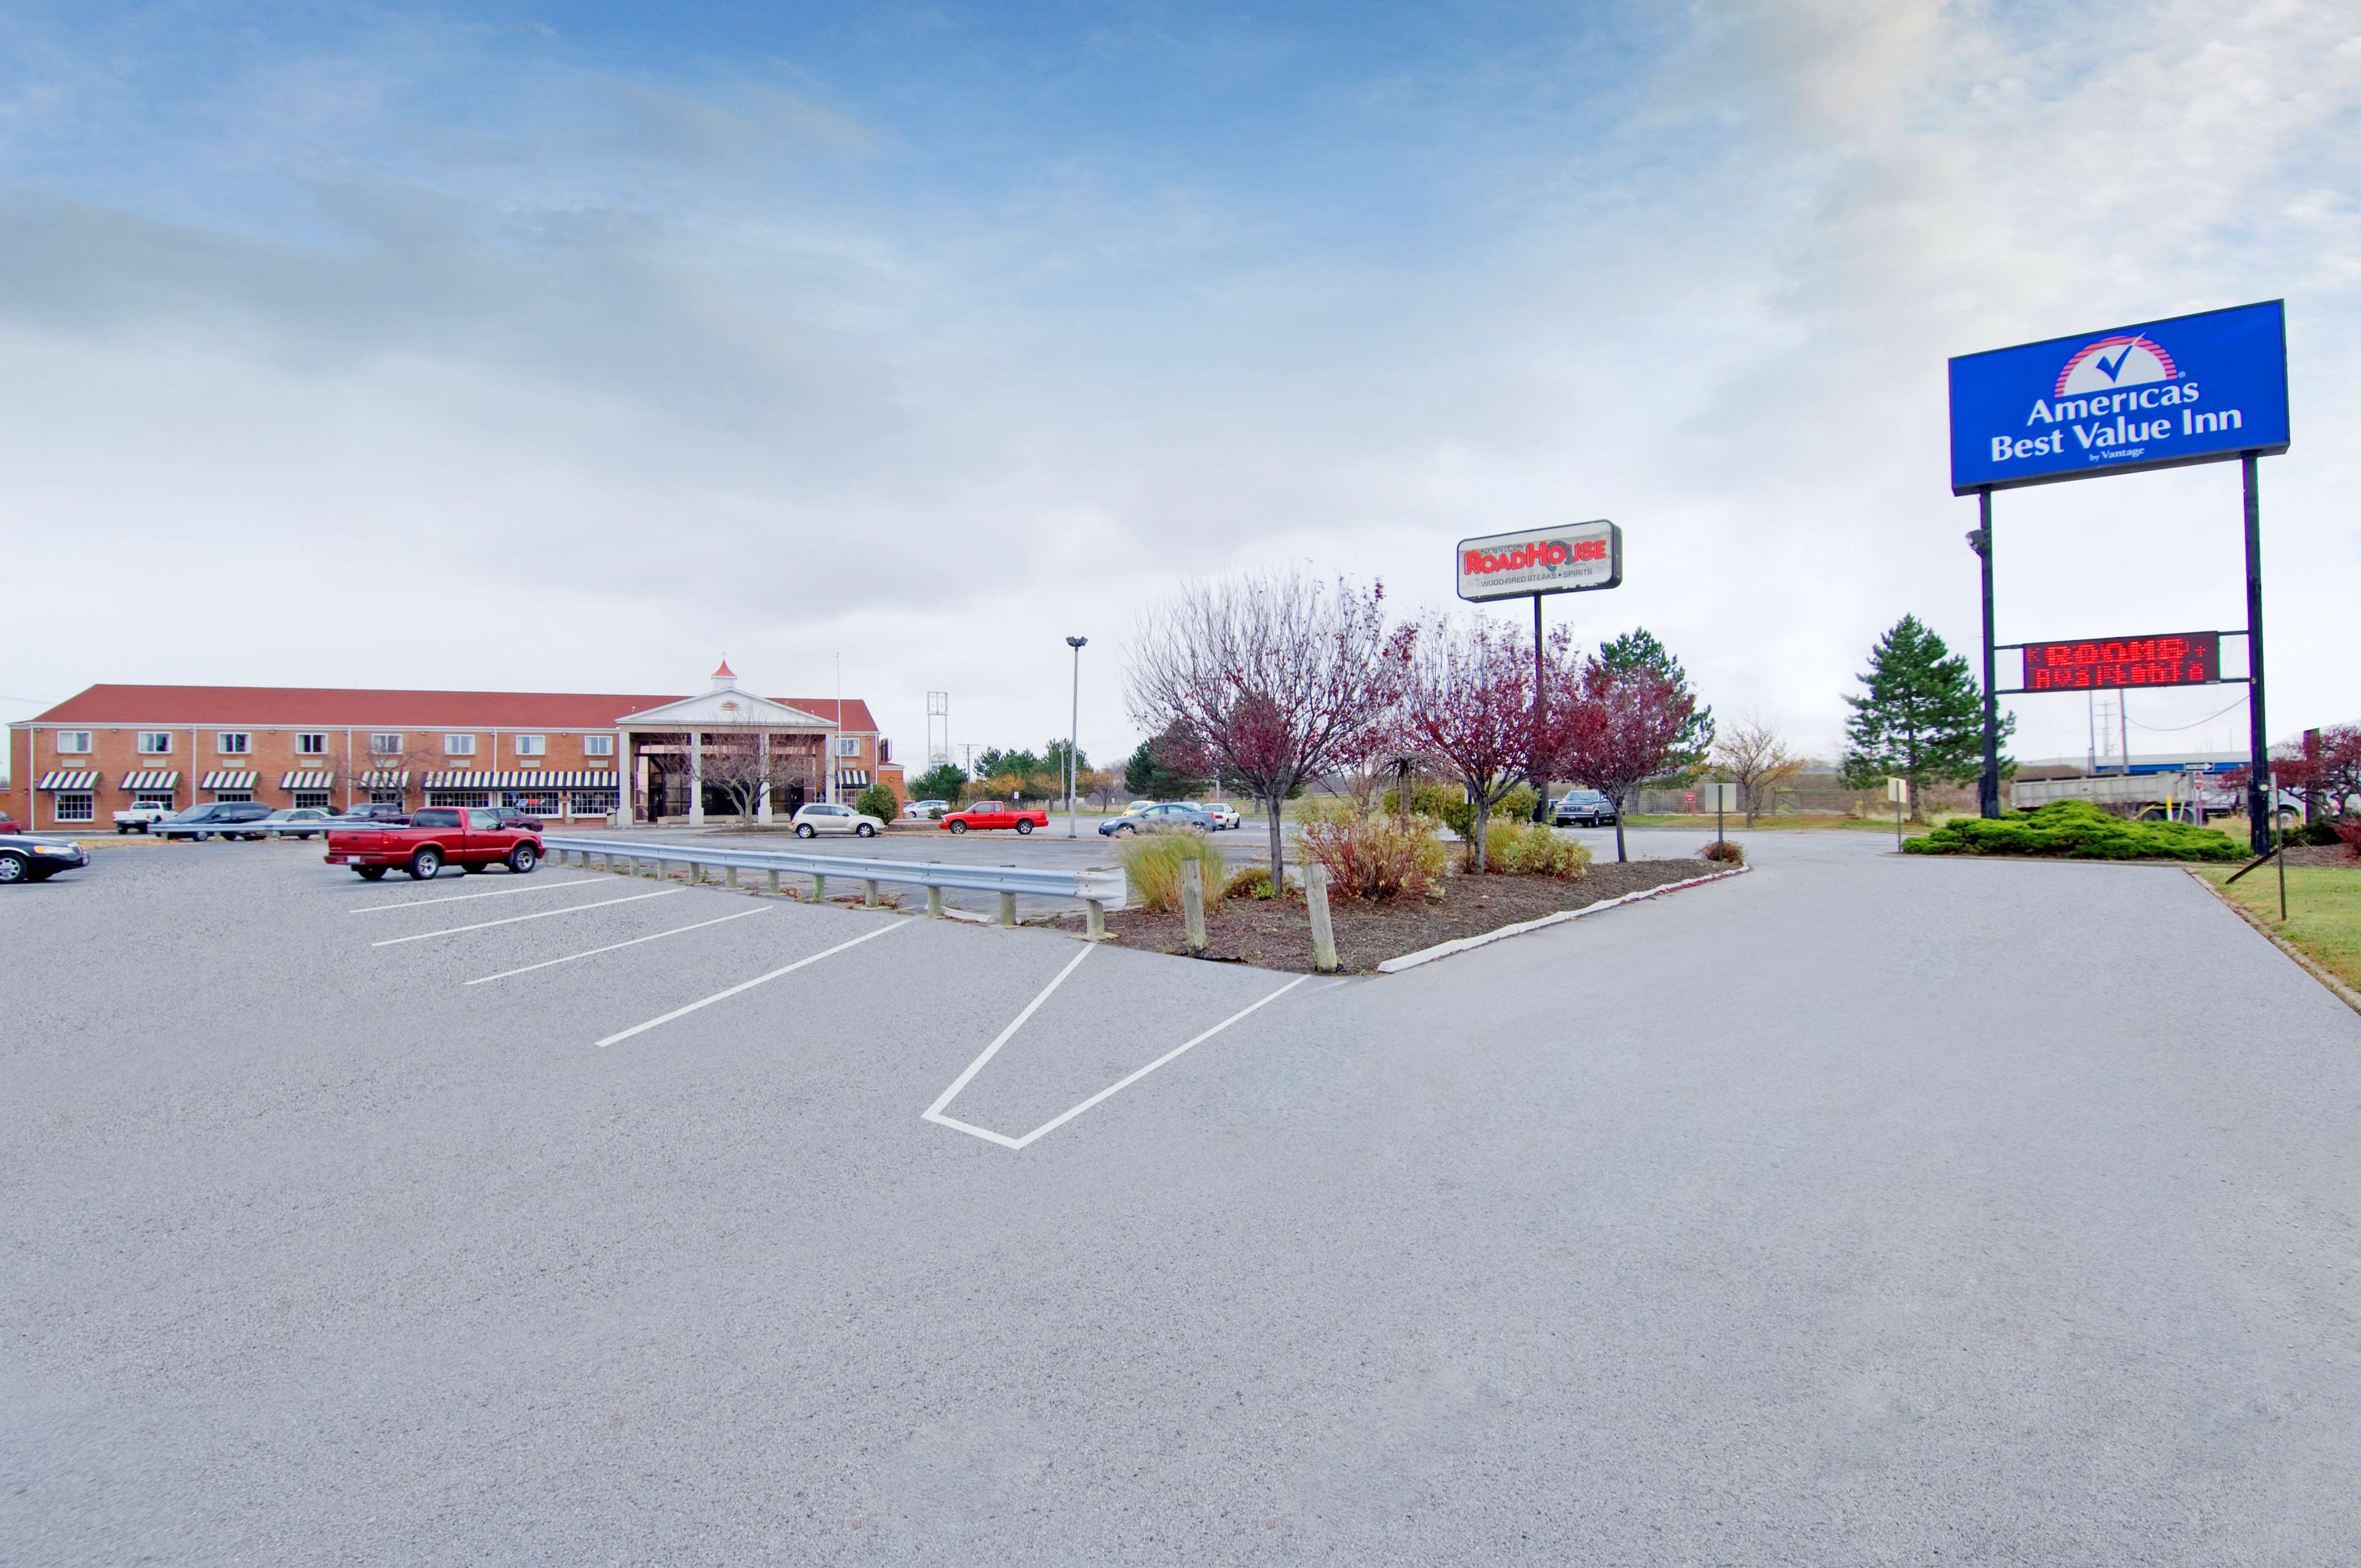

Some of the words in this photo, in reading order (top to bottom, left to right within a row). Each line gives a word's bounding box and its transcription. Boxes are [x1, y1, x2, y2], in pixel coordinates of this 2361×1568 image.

[2027, 381, 2199, 426] Americas
[1992, 434, 2064, 461] Best
[2073, 416, 2171, 449] Value
[2184, 408, 2242, 435] Inn
[2101, 448, 2145, 459] Vantage
[1482, 576, 1526, 587] WOOD-FIRED
[1528, 572, 1557, 582] STEAKS
[1563, 568, 1592, 577] SPIRITS
